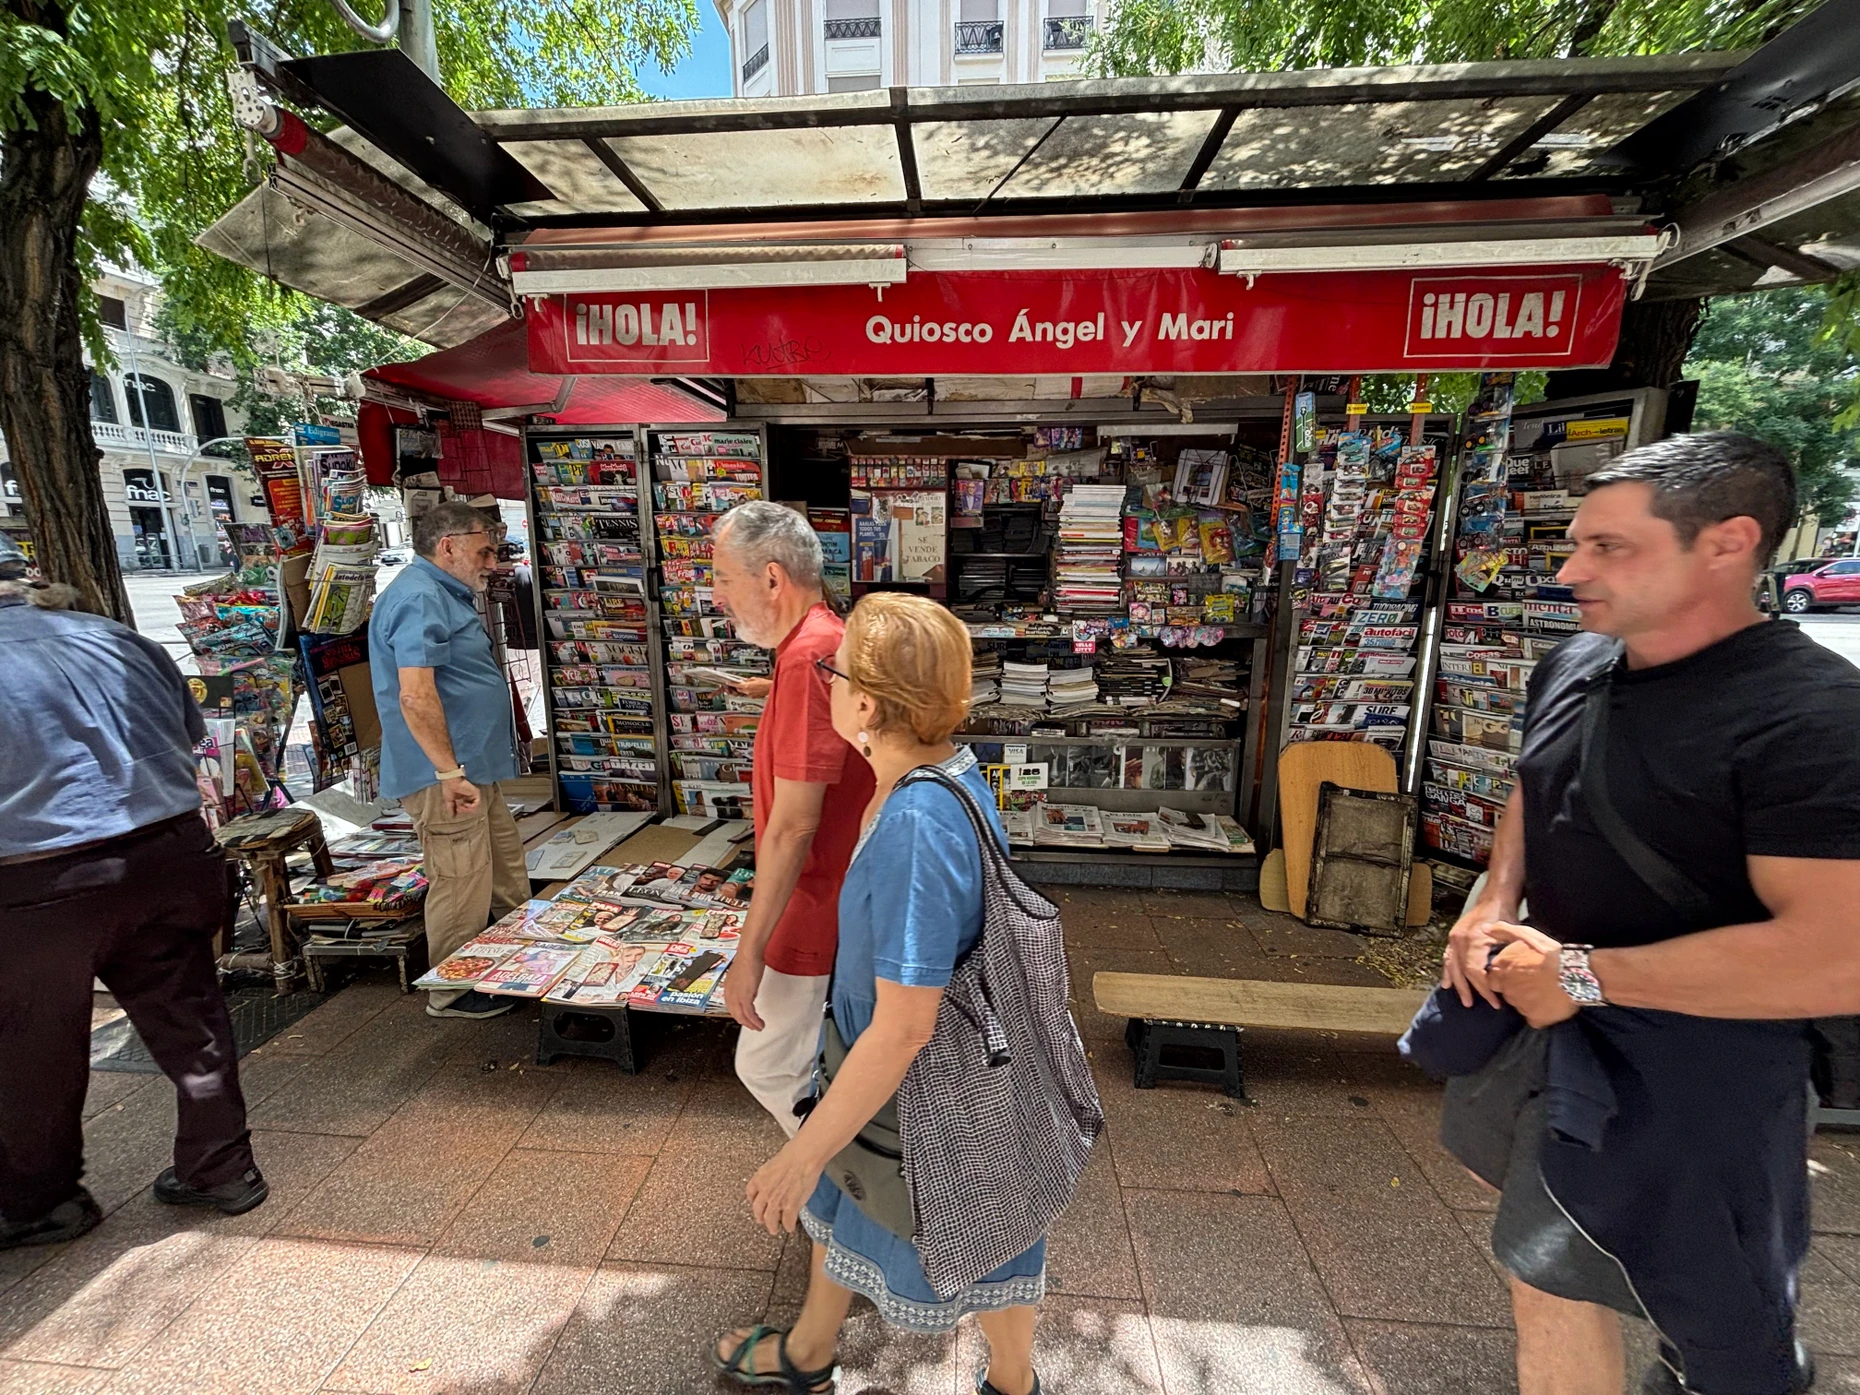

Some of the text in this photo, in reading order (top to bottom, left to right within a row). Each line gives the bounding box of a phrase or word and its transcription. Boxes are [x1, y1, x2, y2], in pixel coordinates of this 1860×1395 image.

[1420, 290, 1566, 340] ¡HOLA!
[575, 303, 697, 346] ¡HOLA!
[865, 308, 1234, 347] Quiosco Ángel y Mari
[596, 519, 638, 530] TENNIS
[908, 545, 938, 554] VENDE
[905, 555, 941, 563] TABACO
[1364, 627, 1415, 637] autofácil
[1465, 651, 1500, 660] Cosas
[1362, 686, 1373, 694] 30
[616, 740, 652, 750] TRAVELLER
[493, 970, 549, 983] ADELGAZA
[660, 995, 675, 1004] en
[670, 991, 704, 1001] pasión
